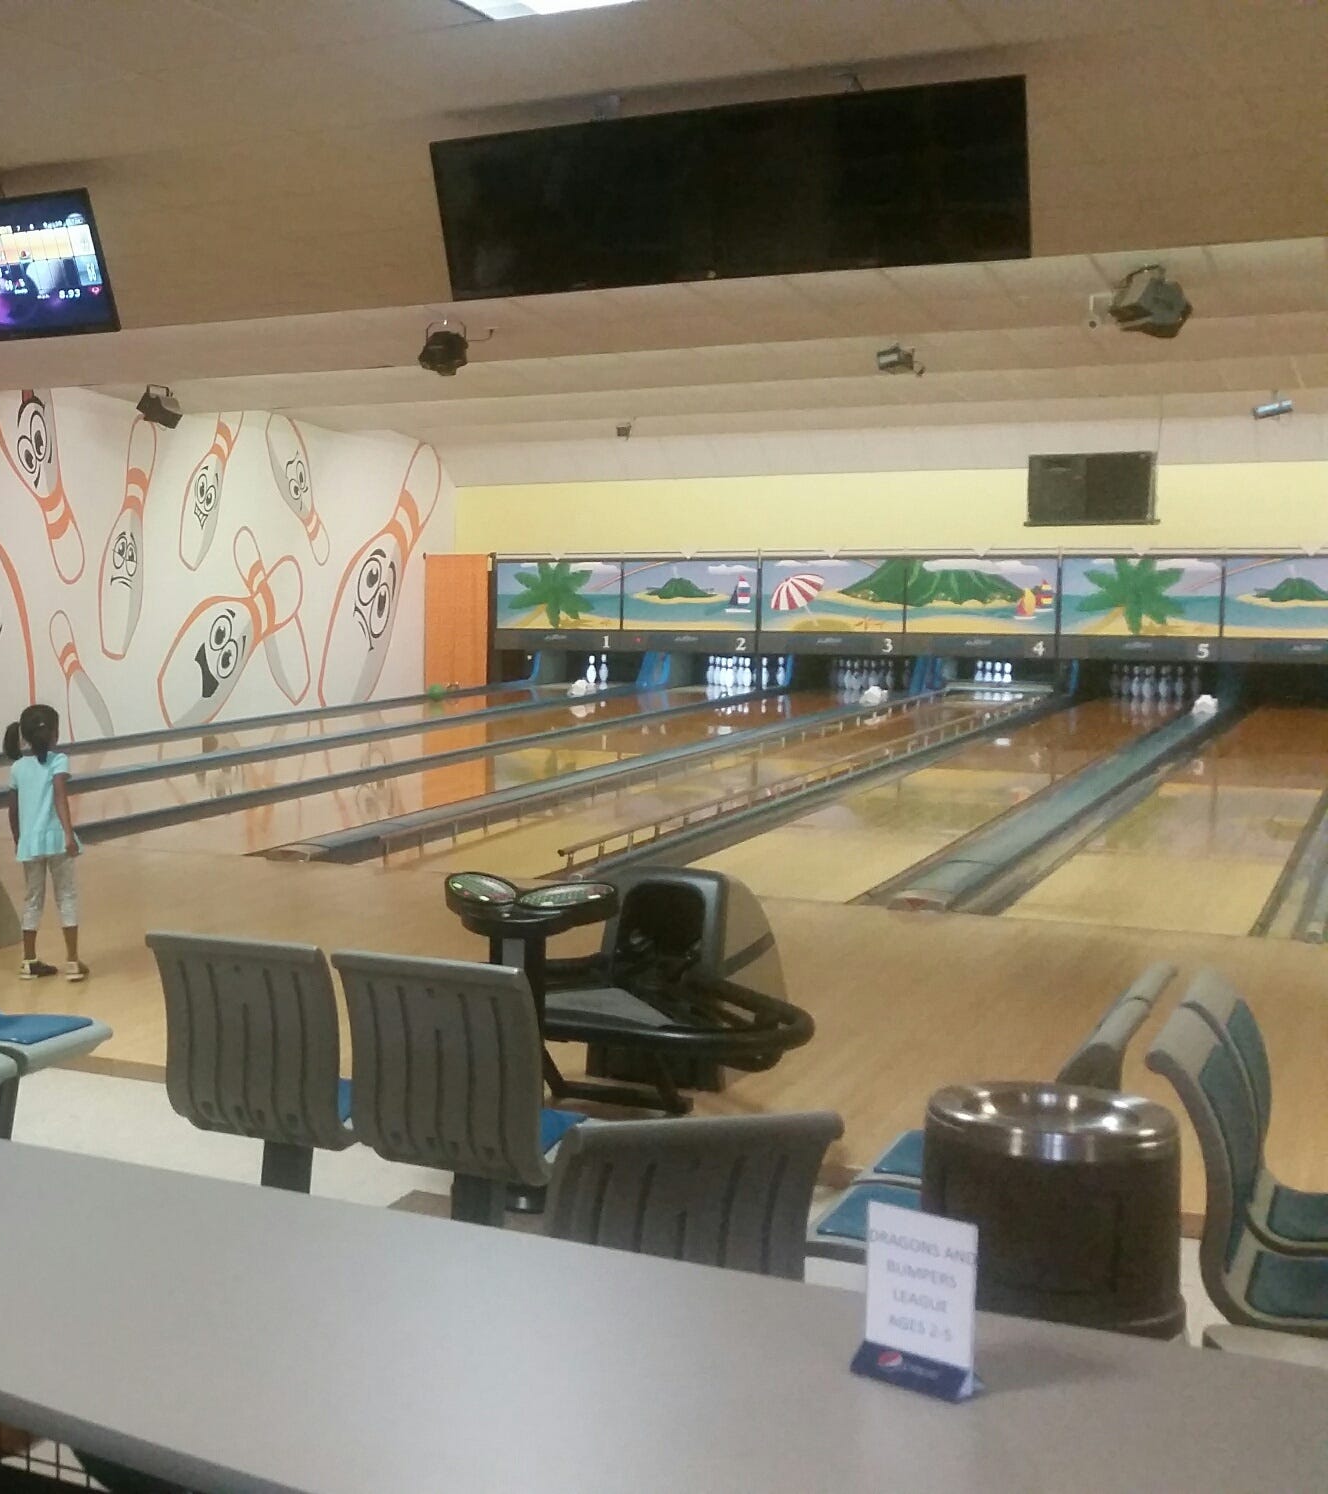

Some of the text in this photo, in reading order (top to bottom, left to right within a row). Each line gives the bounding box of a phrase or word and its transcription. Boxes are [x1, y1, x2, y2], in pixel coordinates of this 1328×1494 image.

[59, 288, 81, 299] 8.93
[601, 635, 610, 649] 1
[735, 637, 746, 651] 2
[882, 638, 893, 652] 3
[1032, 640, 1045, 657] 4
[1197, 643, 1209, 658] 5
[870, 1229, 941, 1258] DRAGONS
[887, 1258, 958, 1289] BUMPERS
[893, 1288, 948, 1313] LEAGUE
